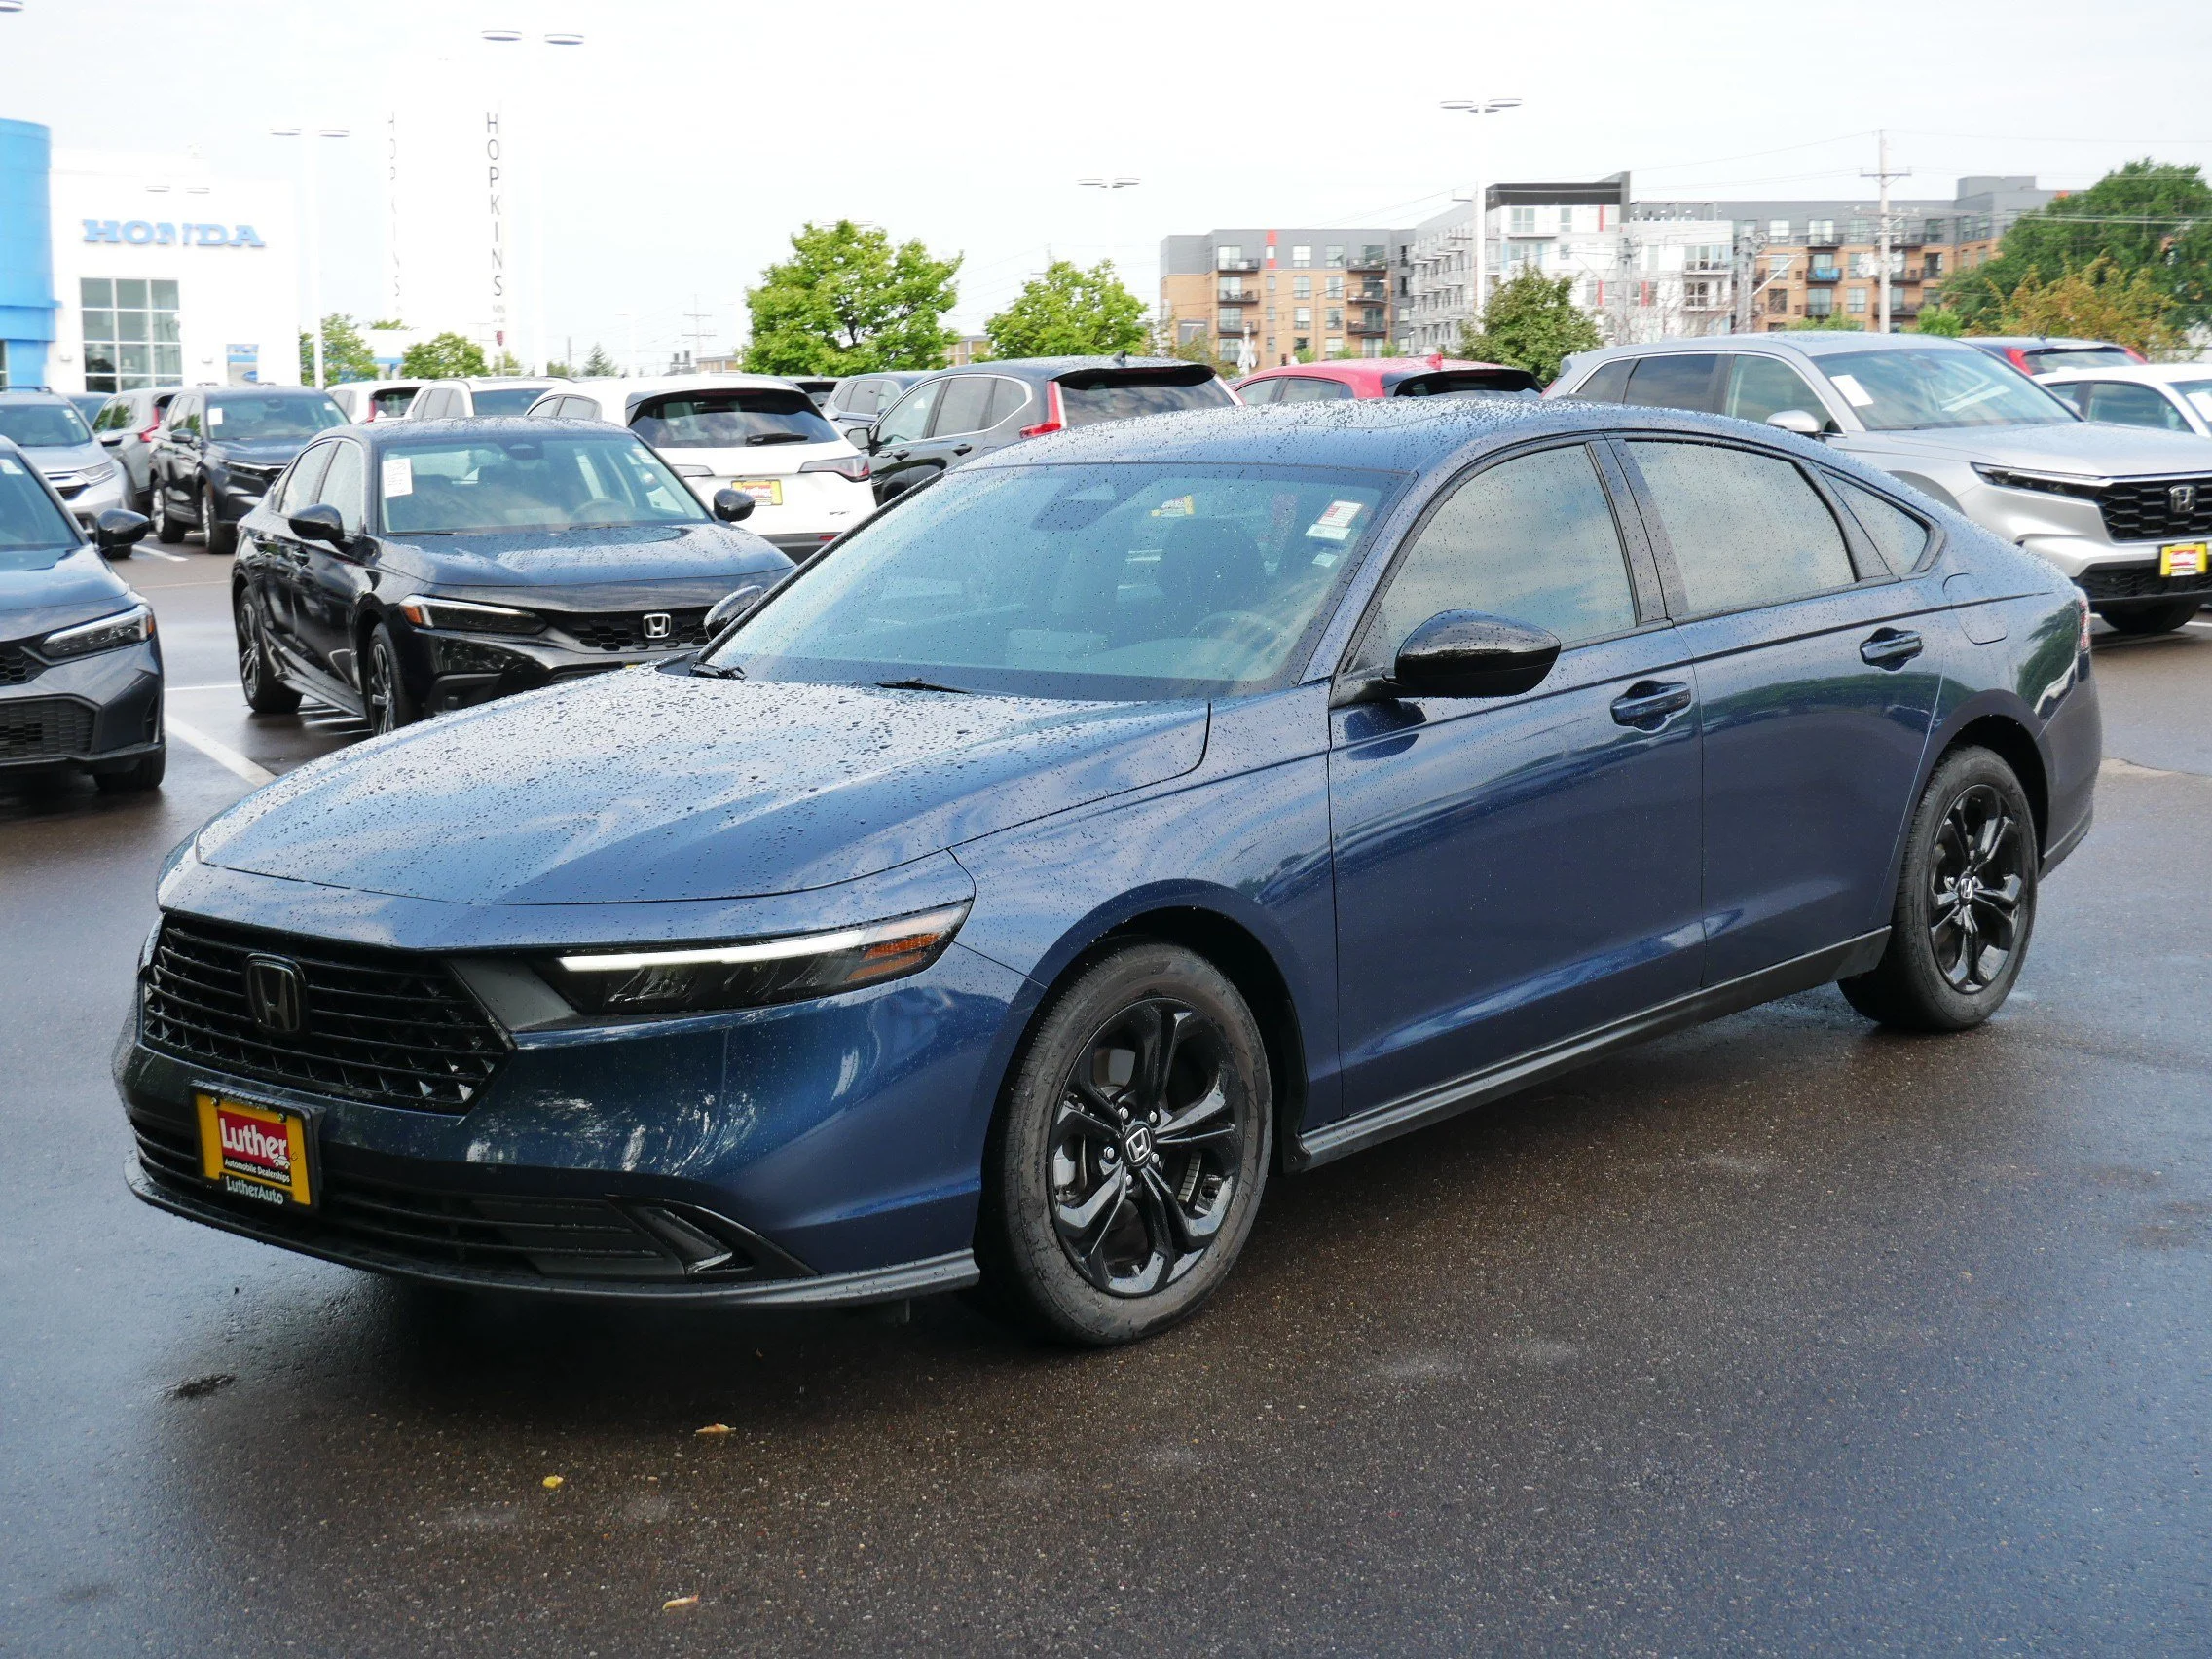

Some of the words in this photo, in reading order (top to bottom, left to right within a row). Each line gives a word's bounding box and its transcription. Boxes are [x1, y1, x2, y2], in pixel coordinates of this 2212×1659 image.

[486, 111, 503, 297] HOPKINS
[82, 219, 267, 247] HONDA
[219, 1117, 287, 1159] Luther
[225, 1159, 256, 1174] Automobile
[257, 1165, 291, 1183] Dealerships
[226, 1175, 284, 1205] LutherAuto
